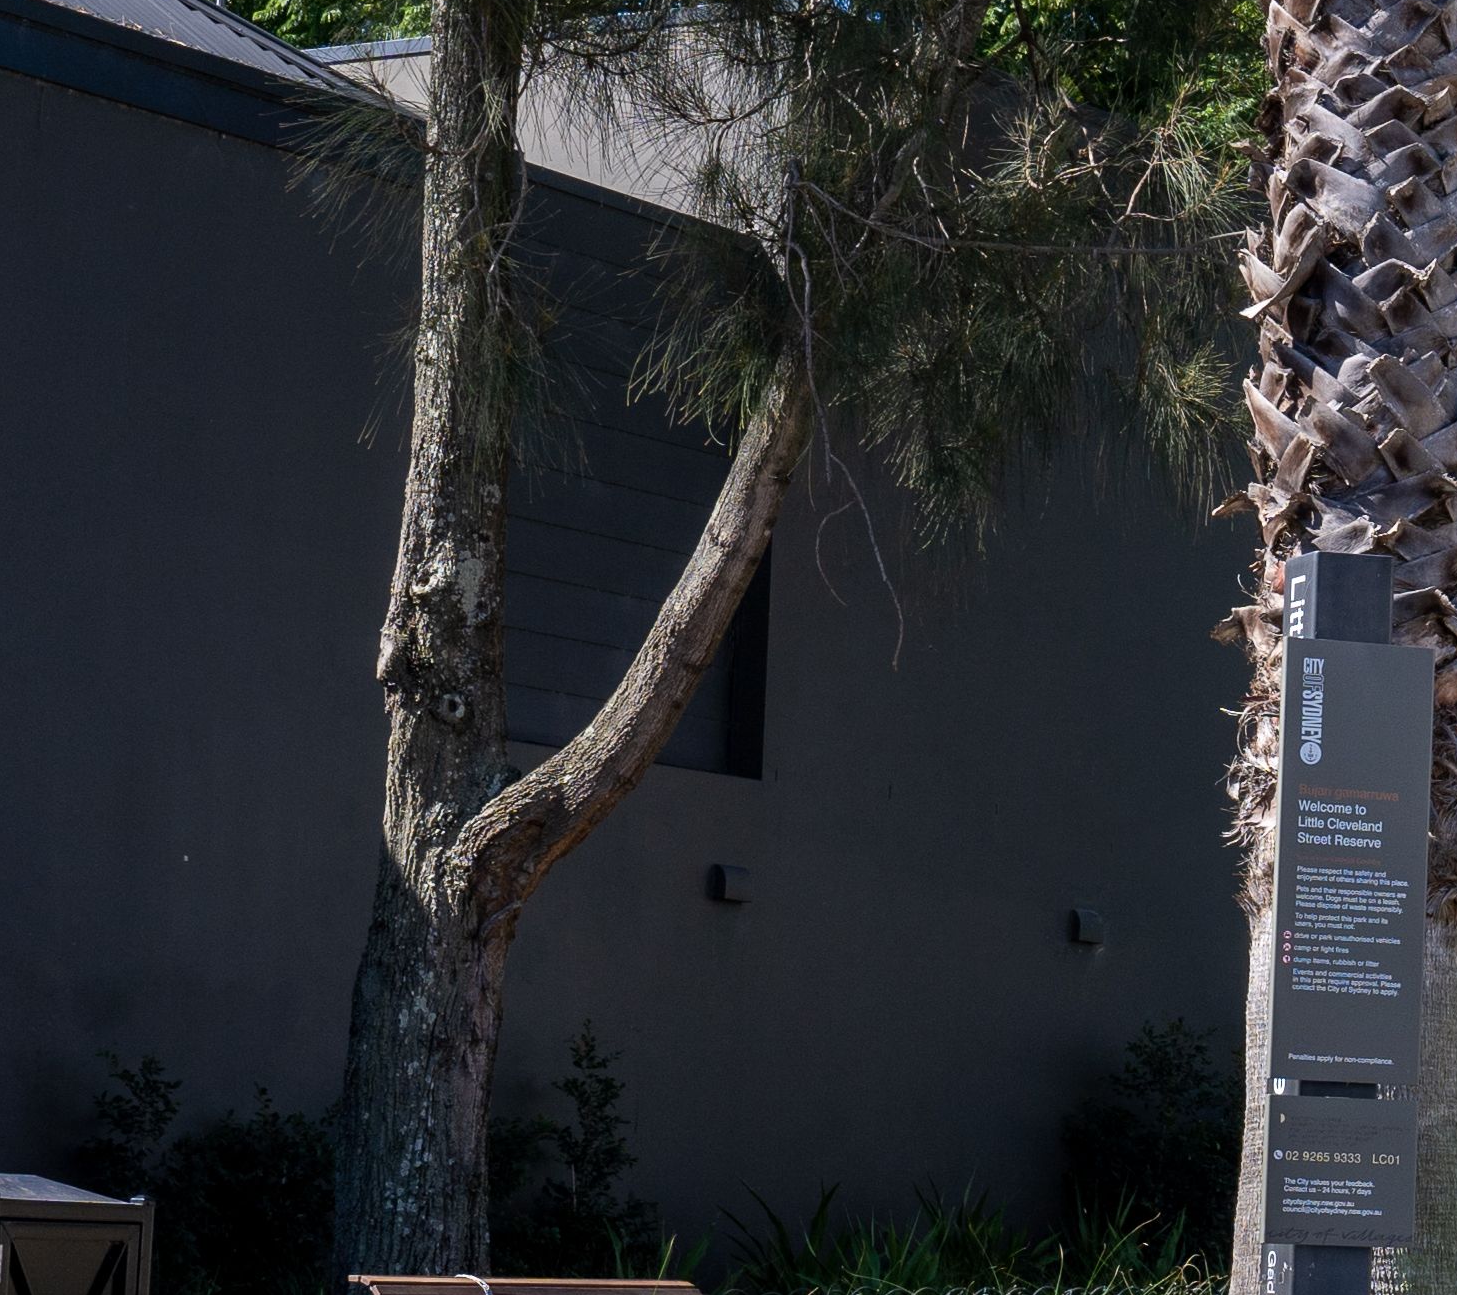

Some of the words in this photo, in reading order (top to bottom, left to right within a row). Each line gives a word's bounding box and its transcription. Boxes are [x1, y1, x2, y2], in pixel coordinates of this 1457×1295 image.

[1290, 575, 1305, 639] Litt
[1299, 800, 1352, 814] Welcome
[1356, 804, 1366, 815] to
[1299, 816, 1324, 828] Little
[1327, 818, 1382, 832] Cleveland
[1298, 832, 1331, 845] Street
[1335, 835, 1381, 848] Reserve
[1297, 865, 1317, 873] Please
[1355, 870, 1373, 878] safety
[1338, 889, 1372, 897] responsible
[1317, 902, 1341, 910] dispose
[1368, 906, 1403, 914] responsibly.
[1349, 987, 1371, 995] Sydney
[1288, 1053, 1315, 1061] Penalties
[1344, 1057, 1394, 1065] non-compliance.
[1286, 1151, 1299, 1161] 02
[1303, 1152, 1330, 1162] 9265
[1334, 1153, 1361, 1163] 9333
[1373, 1154, 1399, 1165] LC01
[1284, 1177, 1295, 1185] The
[1283, 1199, 1354, 1207] cityofsydney.nsw.gov.au
[1283, 1207, 1382, 1216] council@cityofsydney.nsw.gov.au
